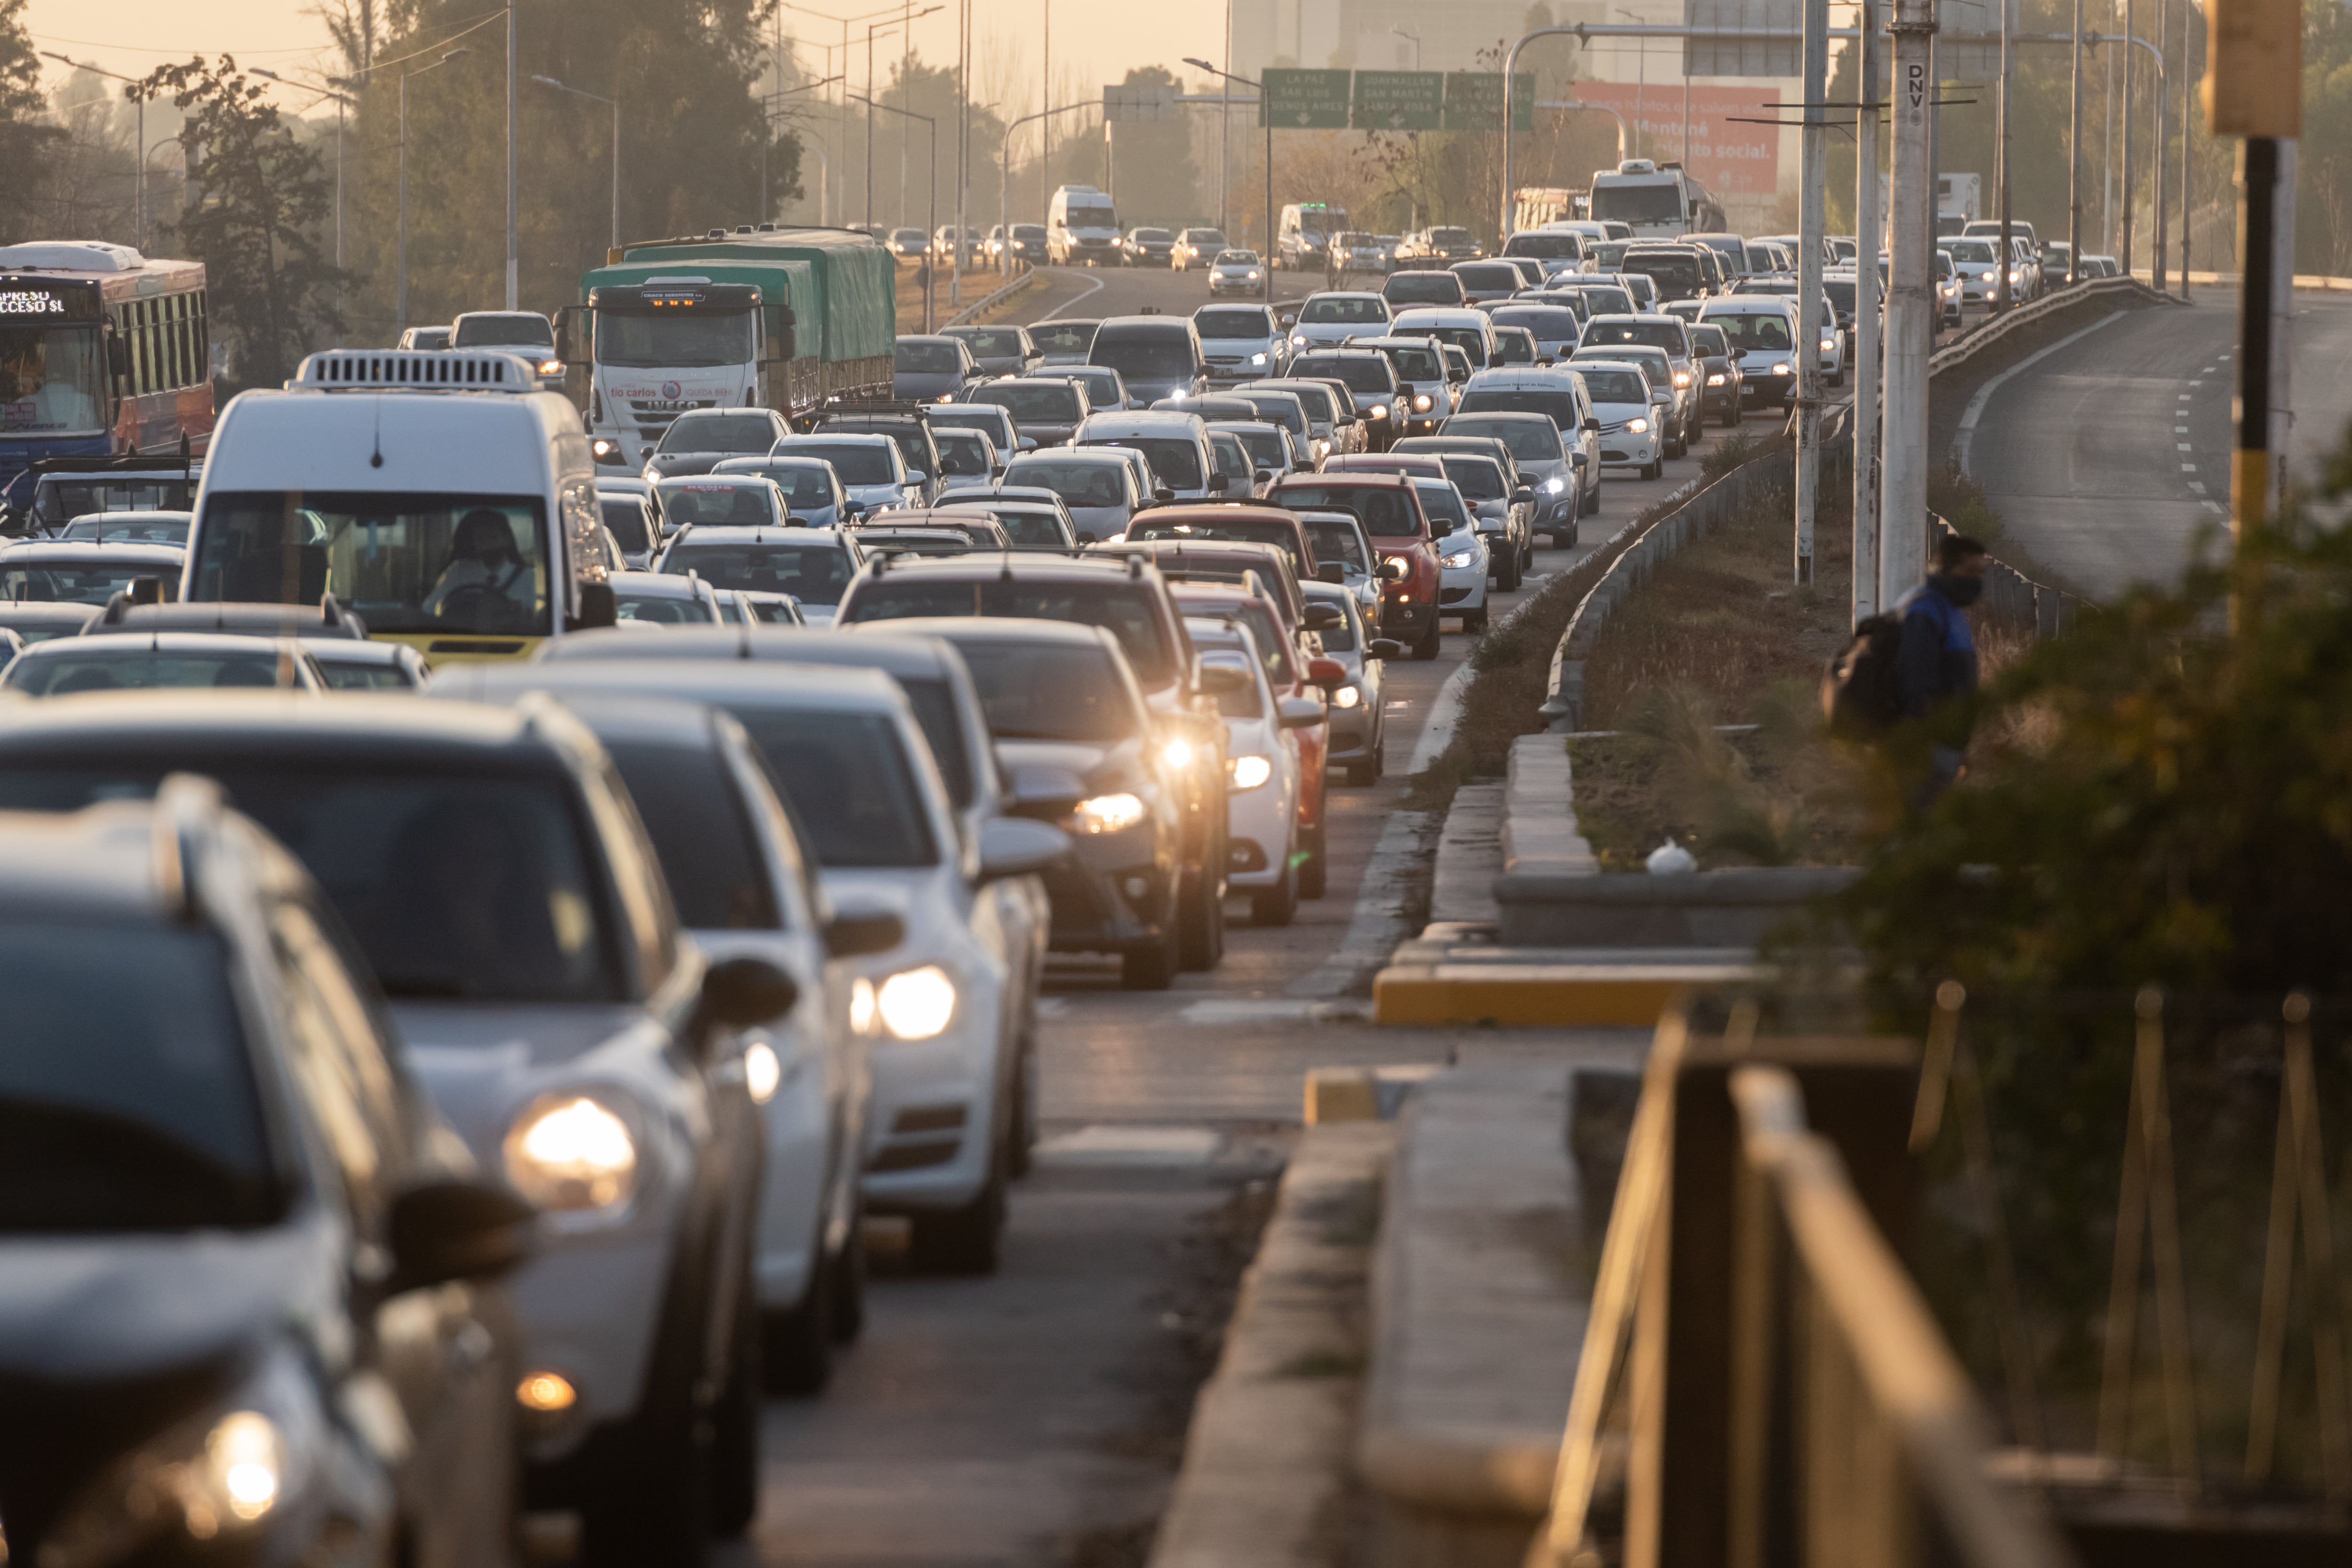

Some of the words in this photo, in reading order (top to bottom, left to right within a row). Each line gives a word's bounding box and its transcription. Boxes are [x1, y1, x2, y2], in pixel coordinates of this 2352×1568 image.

[1286, 74, 1300, 83] LA
[1304, 74, 1326, 84] PAZ
[1364, 75, 1434, 86] GUAYMALLEN
[1909, 65, 1923, 107] DNV
[1280, 87, 1302, 97] SAN
[1306, 88, 1330, 98] LUIS
[1364, 88, 1386, 98] SAN
[1391, 89, 1433, 99] MARTIN
[1311, 101, 1344, 111] AIRES
[1716, 143, 1771, 159] social.
[0, 291, 49, 301] PRESO
[627, 387, 656, 397] carlos
[647, 401, 699, 411] IVECO
